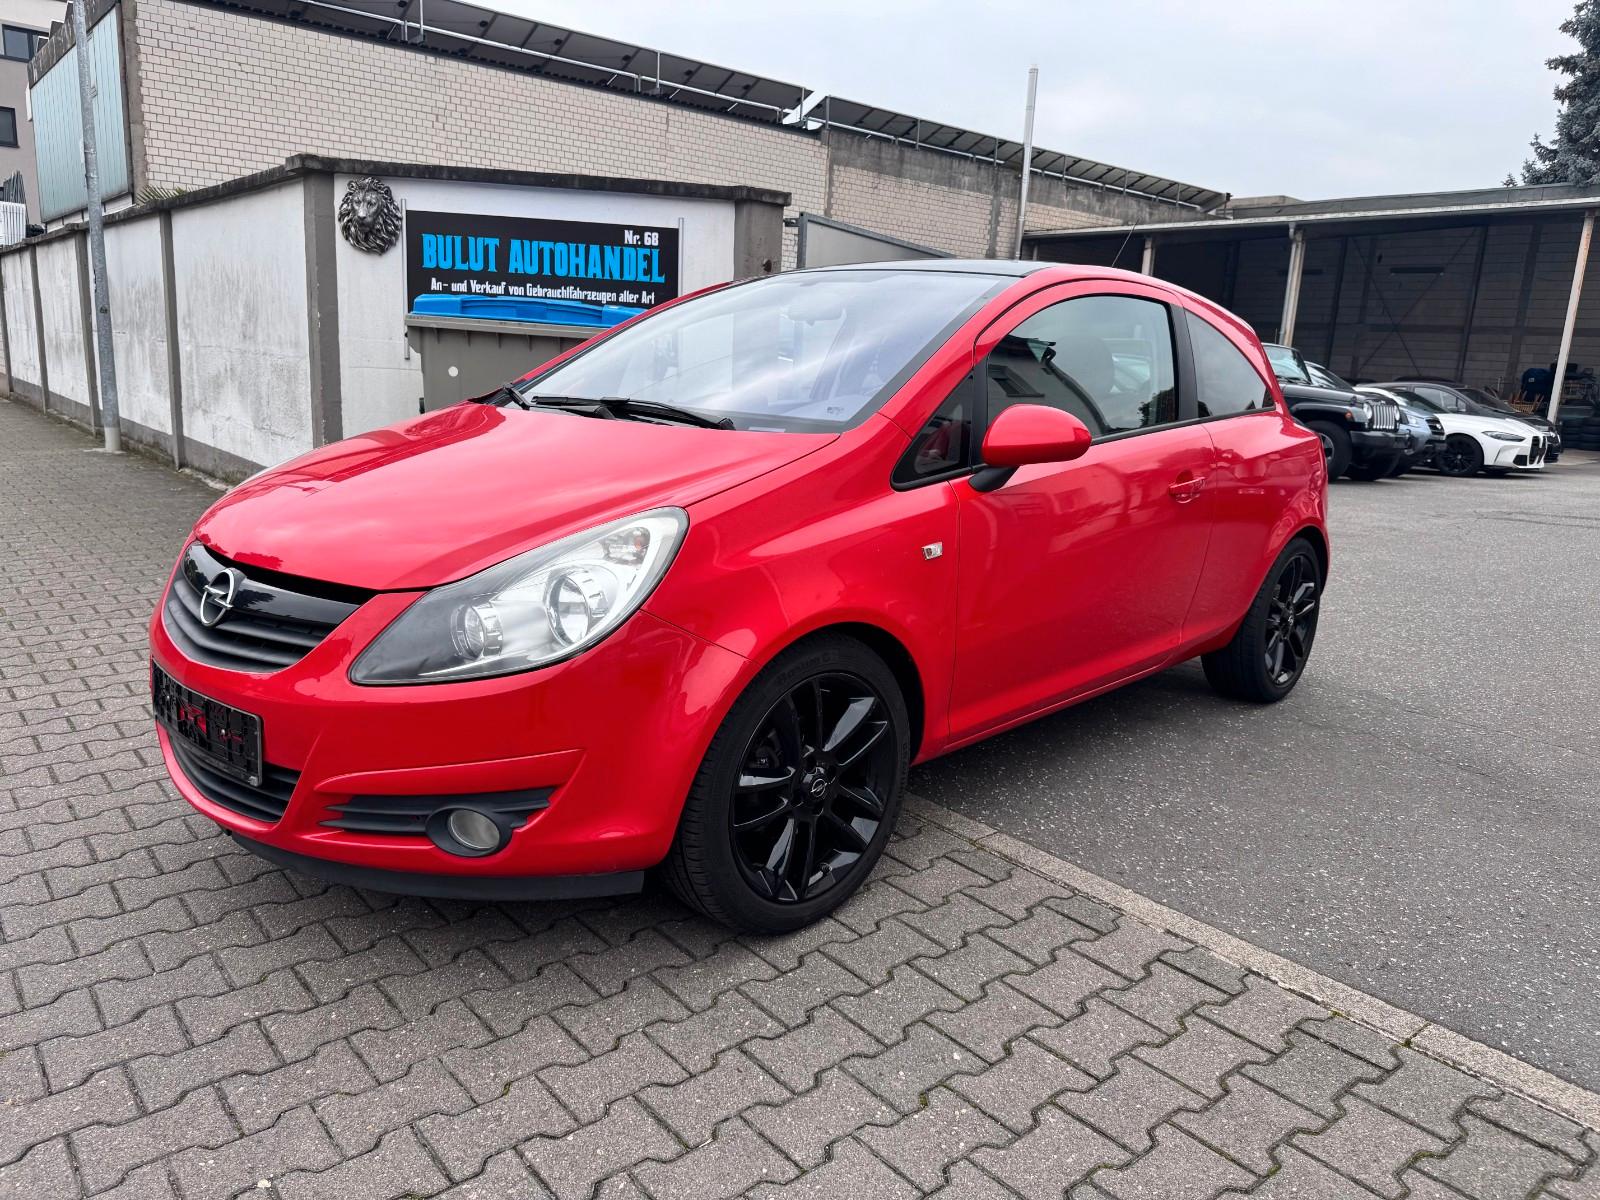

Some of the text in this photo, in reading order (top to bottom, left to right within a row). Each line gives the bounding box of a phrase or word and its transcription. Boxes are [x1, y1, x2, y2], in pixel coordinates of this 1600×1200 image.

[624, 229, 659, 246] Nr. 68
[422, 233, 665, 284] BULUT AUTOHANDEL
[430, 277, 656, 304] An- und Verkauf von Gebrauchtfahrzeugen aller Art
